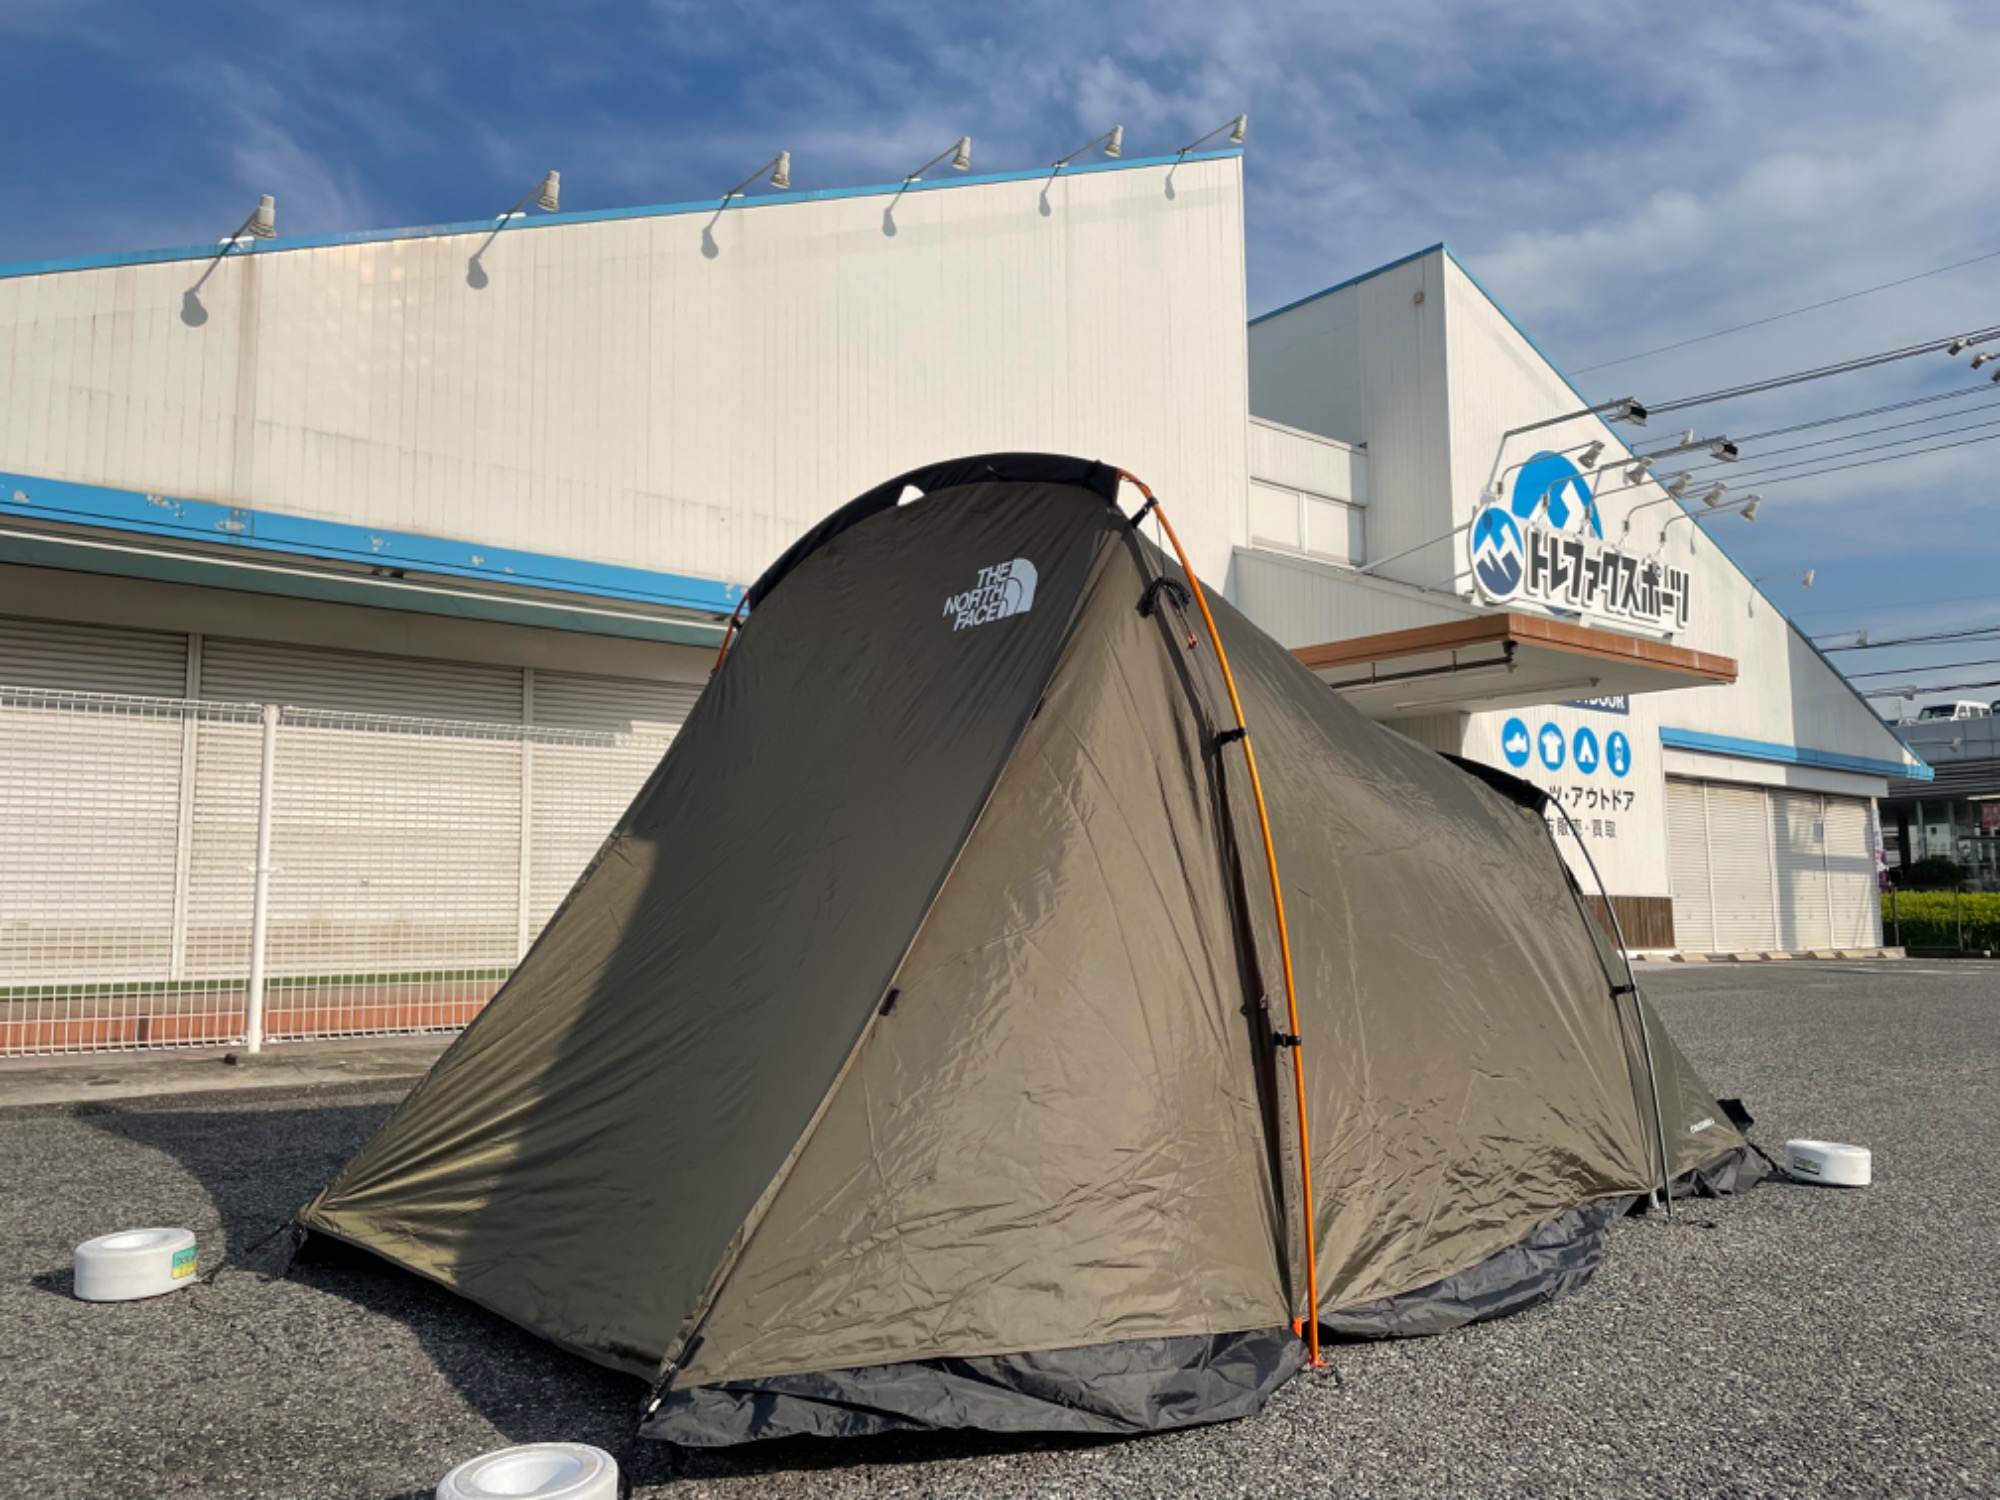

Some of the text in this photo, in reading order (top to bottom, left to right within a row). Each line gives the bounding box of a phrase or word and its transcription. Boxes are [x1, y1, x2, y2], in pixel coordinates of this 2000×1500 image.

[977, 561, 1012, 588] THE
[1529, 530, 1690, 623] トレファクスポーツ
[942, 582, 1006, 617] NORTH
[953, 601, 1001, 631] FACE
